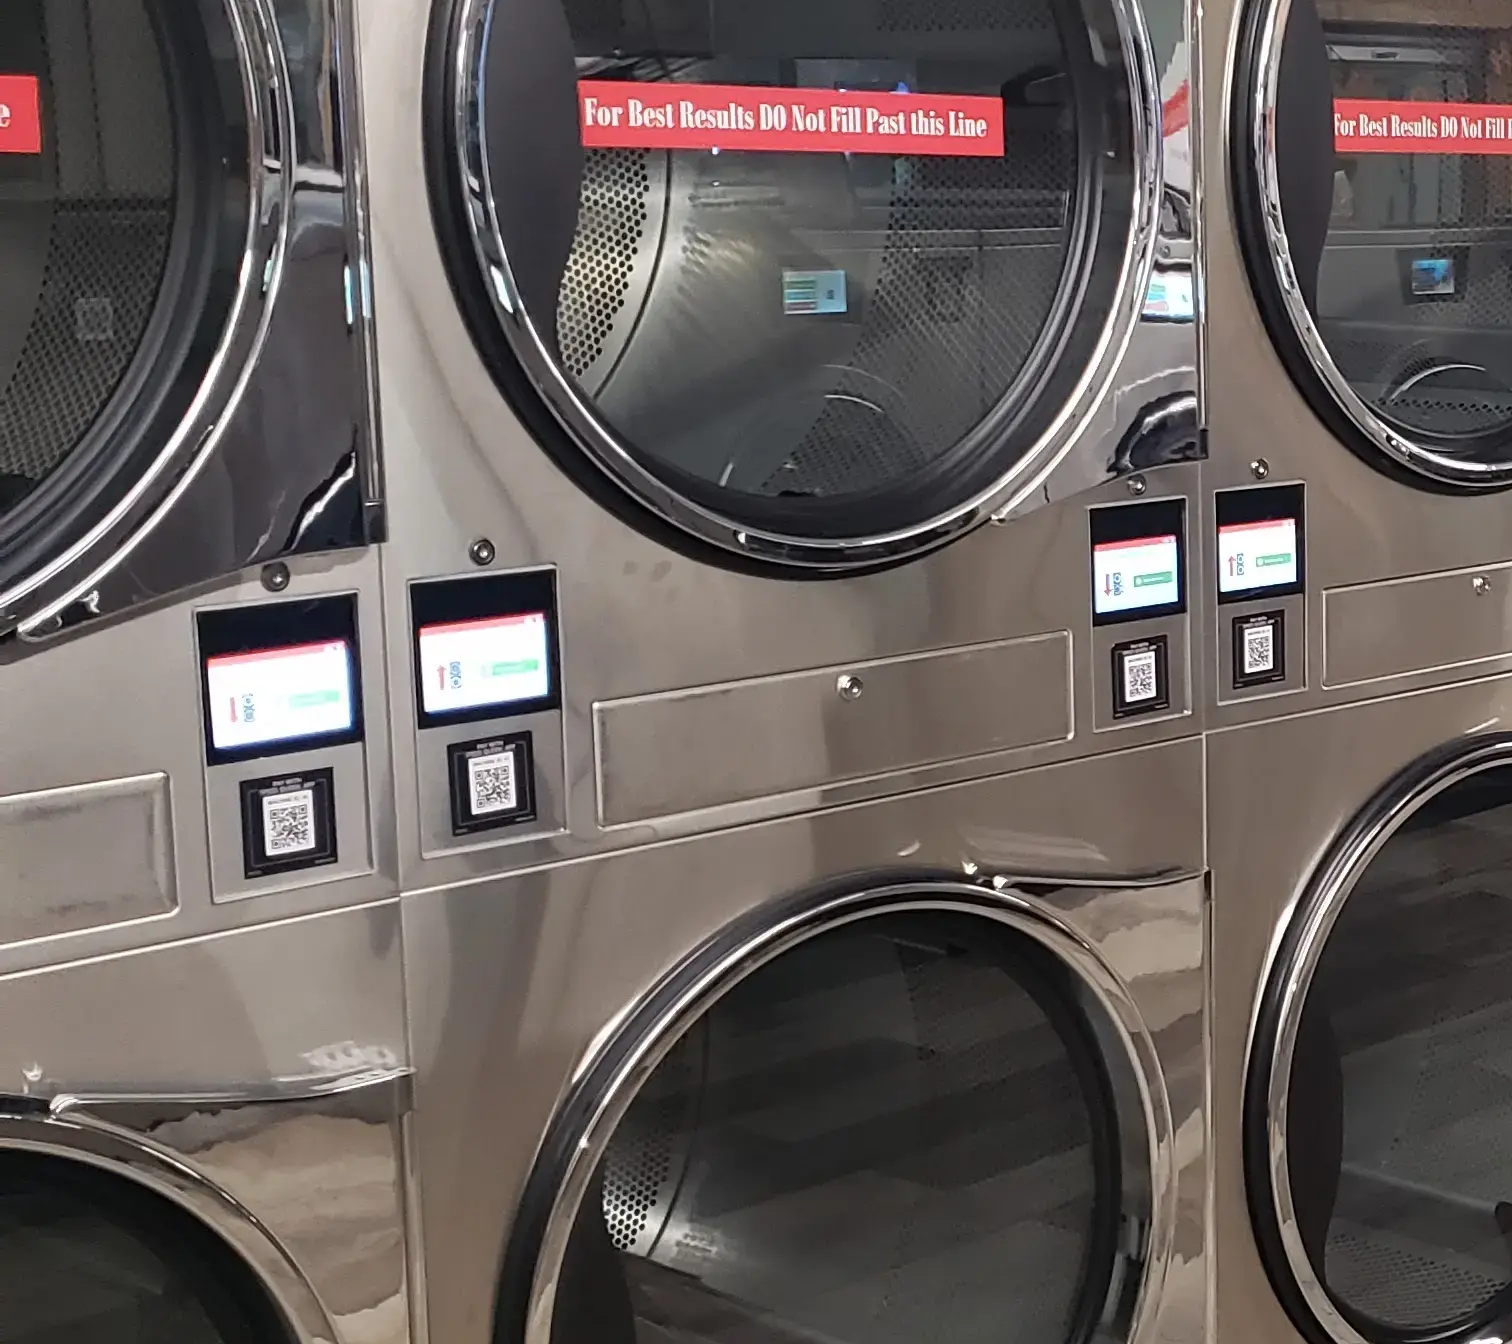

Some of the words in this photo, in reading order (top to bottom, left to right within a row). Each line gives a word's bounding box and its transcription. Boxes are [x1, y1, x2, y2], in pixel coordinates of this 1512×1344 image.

[583, 97, 623, 127] For
[628, 98, 675, 128] Best
[679, 100, 754, 130] Results
[759, 103, 786, 131] DO
[792, 104, 826, 133] Not
[830, 106, 862, 133] Fill
[866, 107, 906, 135] Past
[911, 109, 945, 136] this
[948, 110, 987, 138] Line
[1334, 113, 1356, 136] For
[1359, 113, 1388, 137] Best
[1391, 114, 1438, 138] Results
[1440, 115, 1458, 138] DO
[1461, 116, 1483, 139] Not
[1485, 117, 1505, 139] Fill
